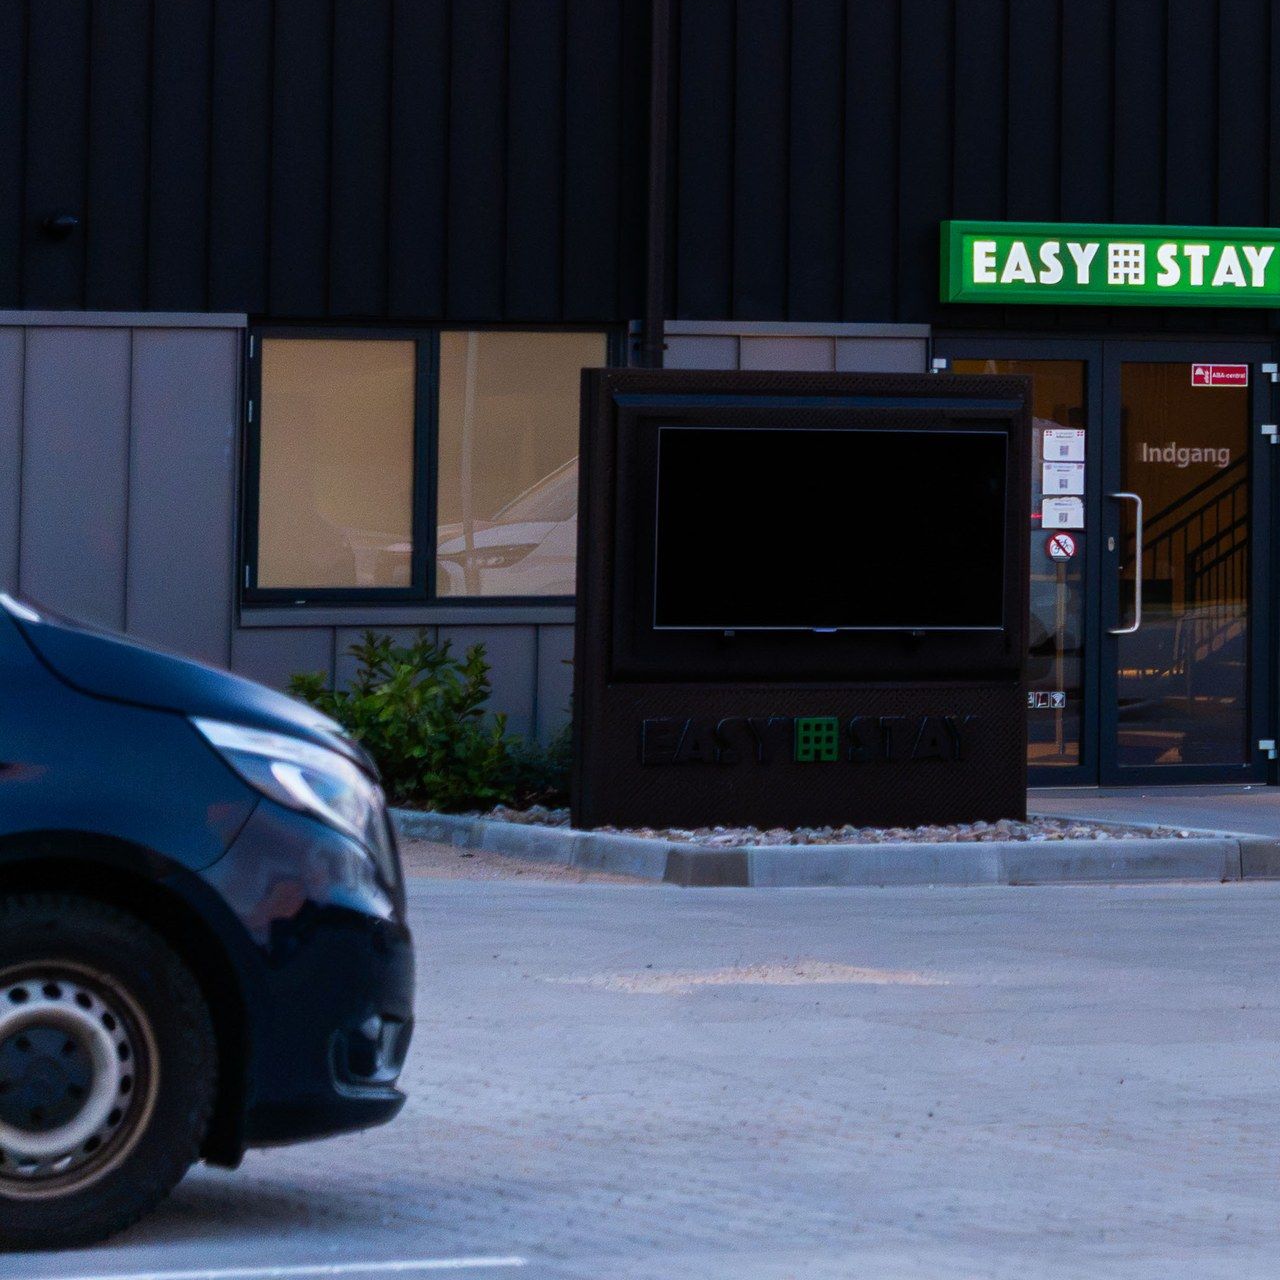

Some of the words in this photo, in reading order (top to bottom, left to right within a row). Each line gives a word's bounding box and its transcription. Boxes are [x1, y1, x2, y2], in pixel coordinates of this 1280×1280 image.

[972, 240, 1100, 285] EASY
[1156, 243, 1276, 288] STAY
[1142, 441, 1231, 468] Indgang
